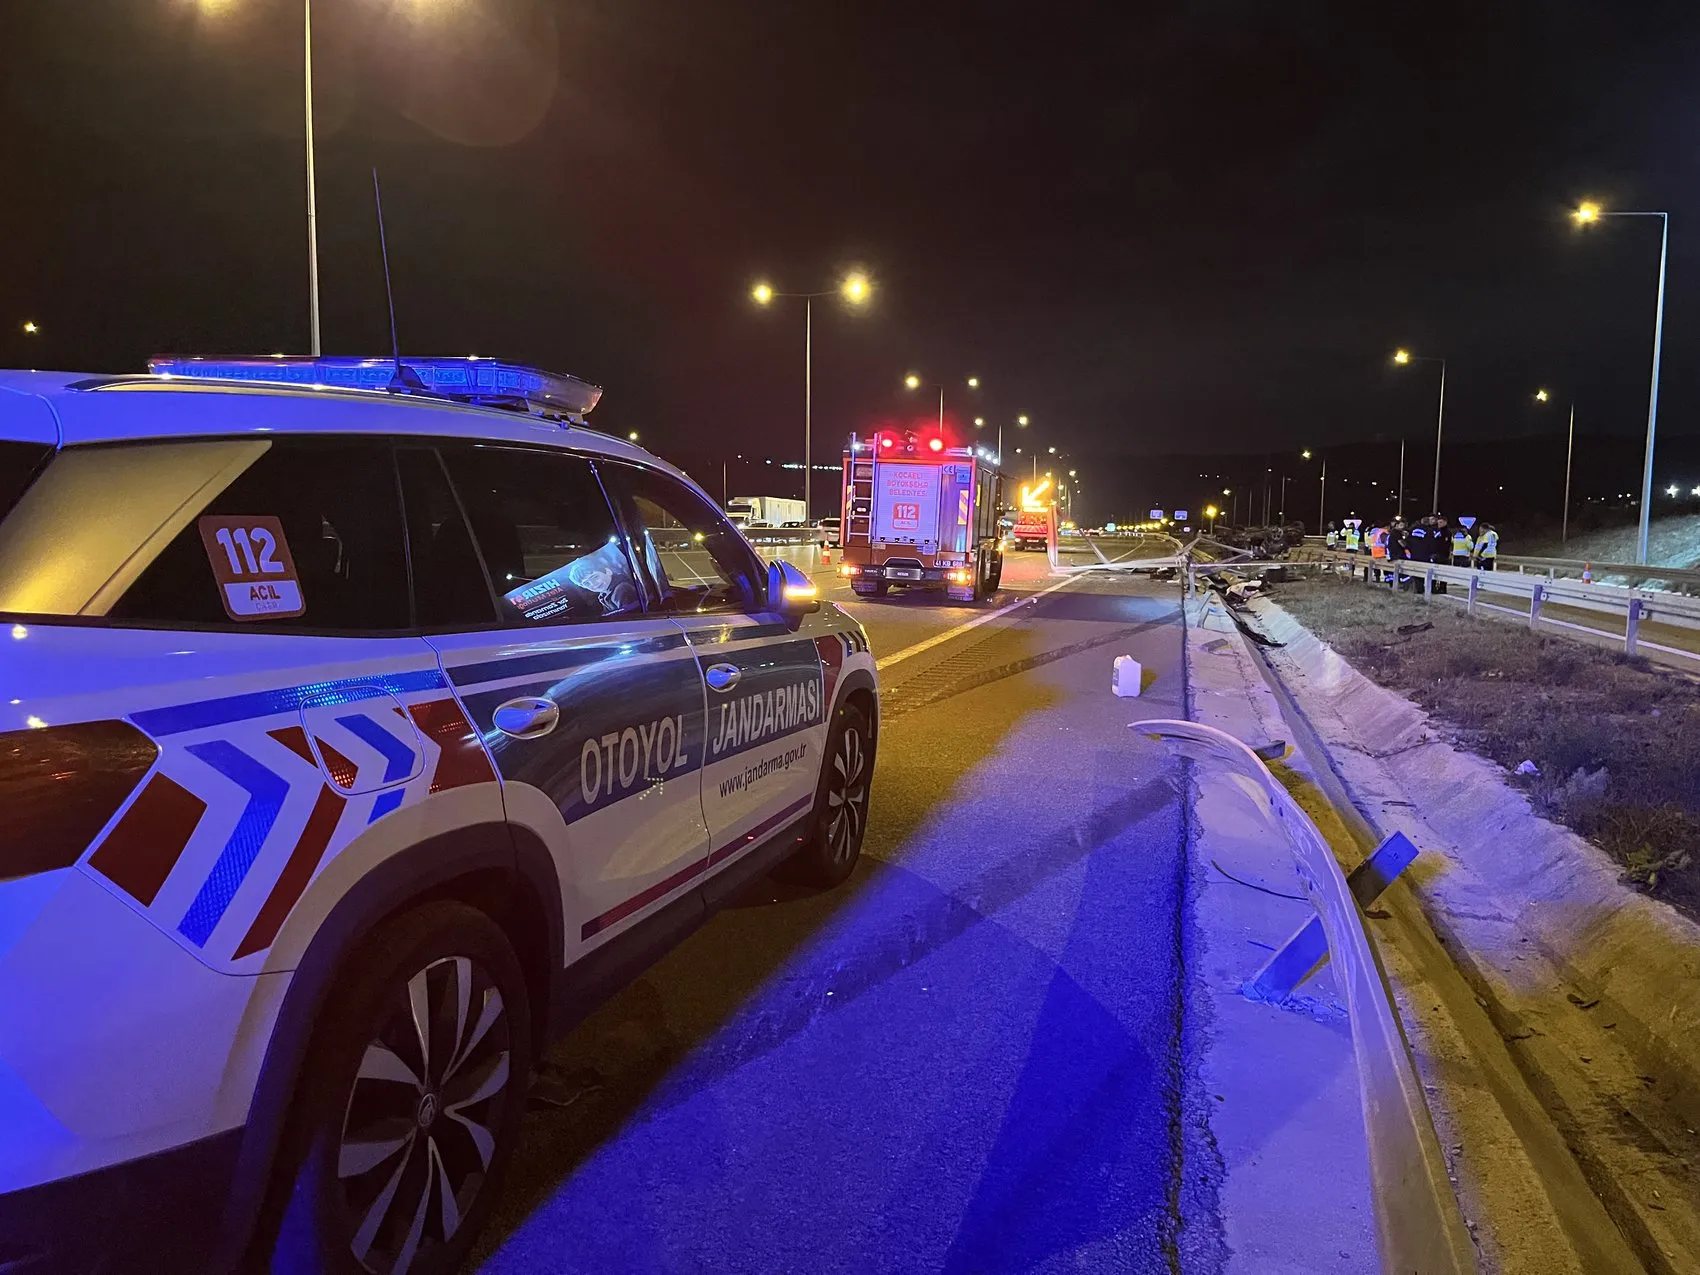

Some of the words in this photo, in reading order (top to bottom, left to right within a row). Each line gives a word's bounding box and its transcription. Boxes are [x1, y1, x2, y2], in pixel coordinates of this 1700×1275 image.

[896, 505, 916, 519] 112
[215, 527, 285, 574] 112
[581, 714, 687, 805] OTOYOL
[712, 678, 820, 755] JANDARMASI
[719, 742, 807, 799] www.jandarma.gov.tr
